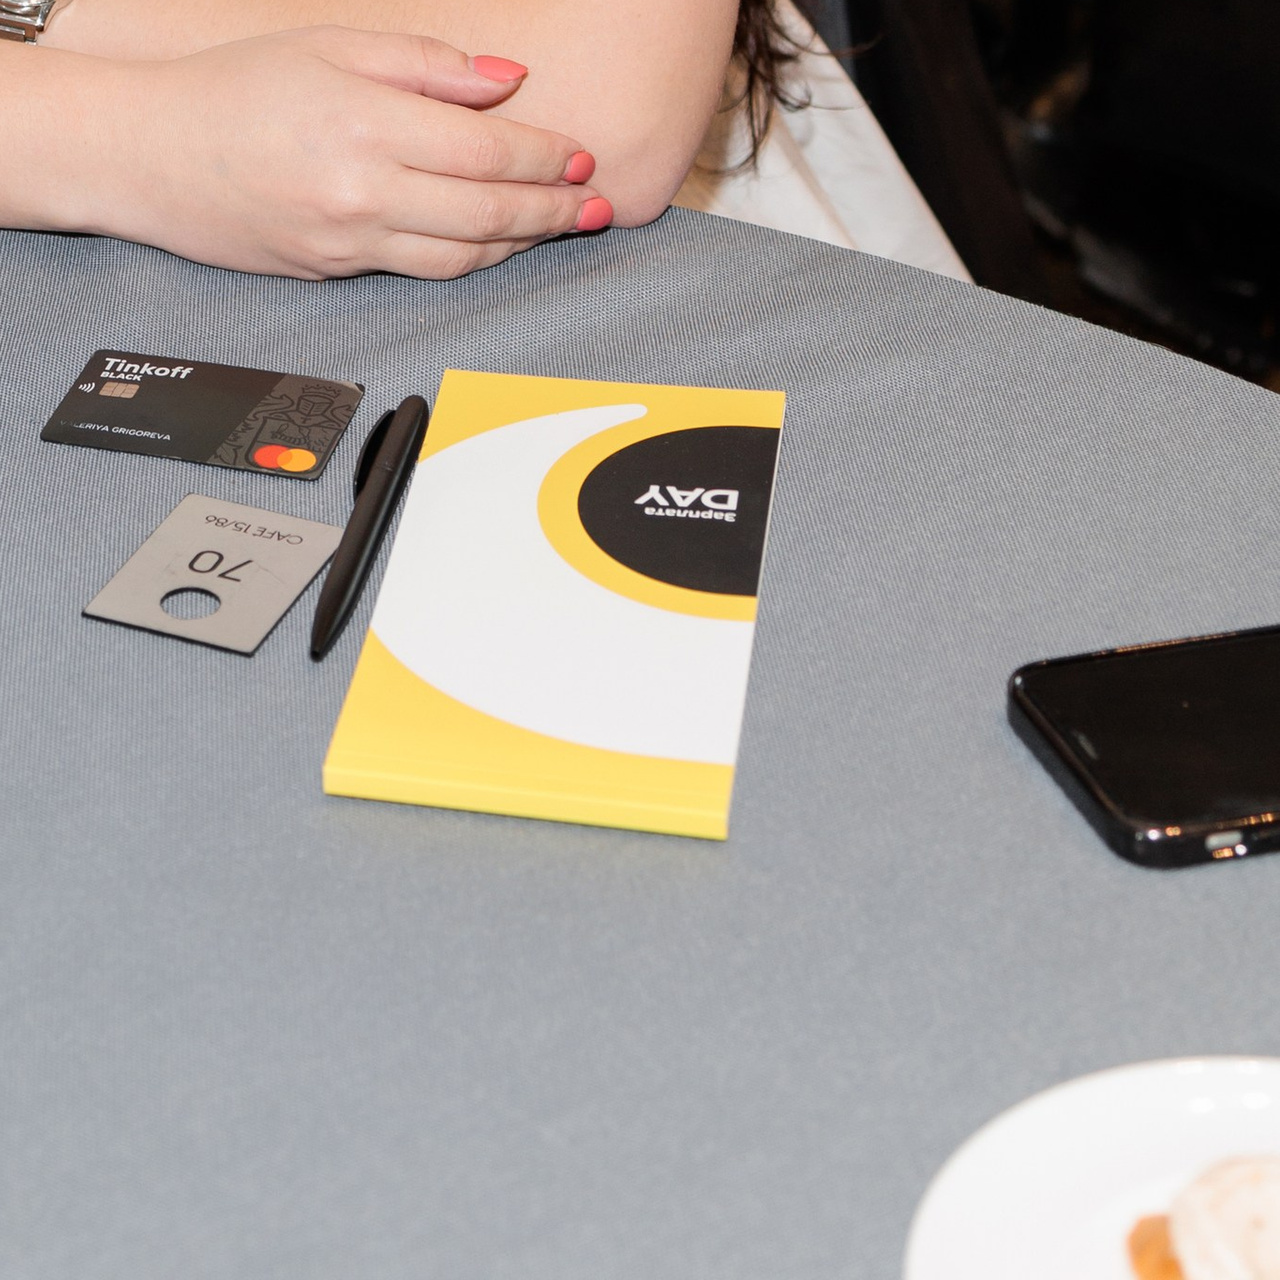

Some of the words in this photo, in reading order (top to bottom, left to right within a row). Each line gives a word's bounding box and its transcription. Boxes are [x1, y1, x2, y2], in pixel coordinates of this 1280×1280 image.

[99, 371, 143, 382] BLACK
[103, 357, 195, 380] Tinkoff
[111, 426, 172, 442] GRIGOREVA
[633, 484, 740, 511] DAY
[204, 514, 251, 534] 15/86
[643, 506, 738, 523] Зарплата
[188, 550, 254, 582] 70
